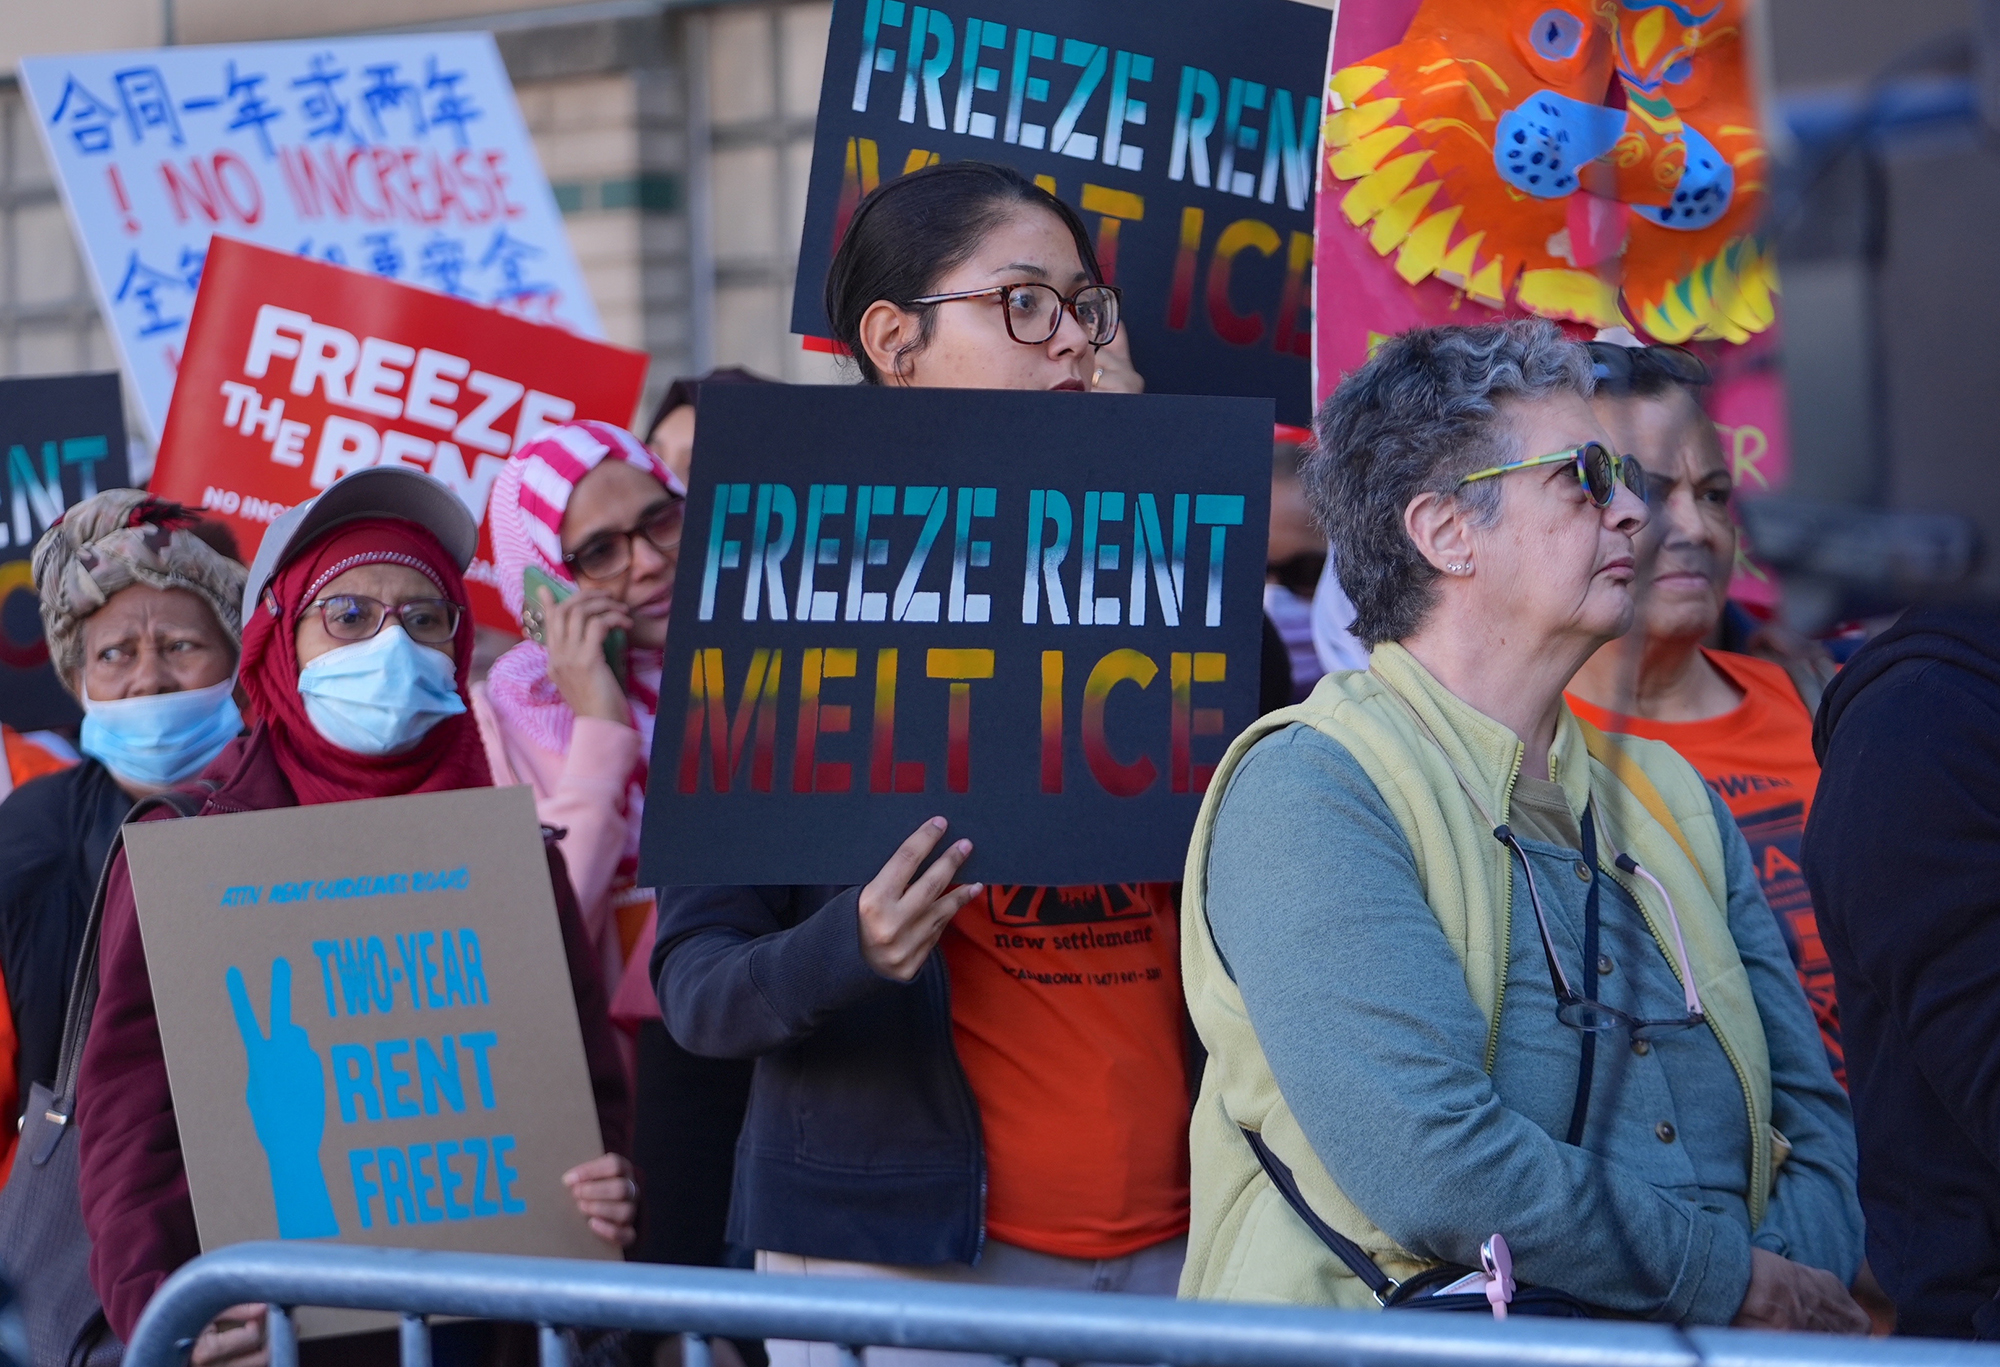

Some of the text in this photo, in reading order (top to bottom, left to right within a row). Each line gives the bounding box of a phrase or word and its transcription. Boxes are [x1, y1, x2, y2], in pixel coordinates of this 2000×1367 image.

[851, 0, 1321, 211] FREEZE REN
[160, 148, 264, 226] NO
[277, 144, 525, 225] INCREASE
[220, 380, 311, 467] THE
[201, 485, 241, 515] NO
[698, 483, 1245, 626] FREEZE RENT
[677, 648, 1227, 796] MELT ICE
[312, 928, 490, 1018] TWO-YEAR
[994, 926, 1153, 949] new settlement
[331, 1031, 498, 1124] RENT
[348, 1135, 527, 1229] FREEZE
